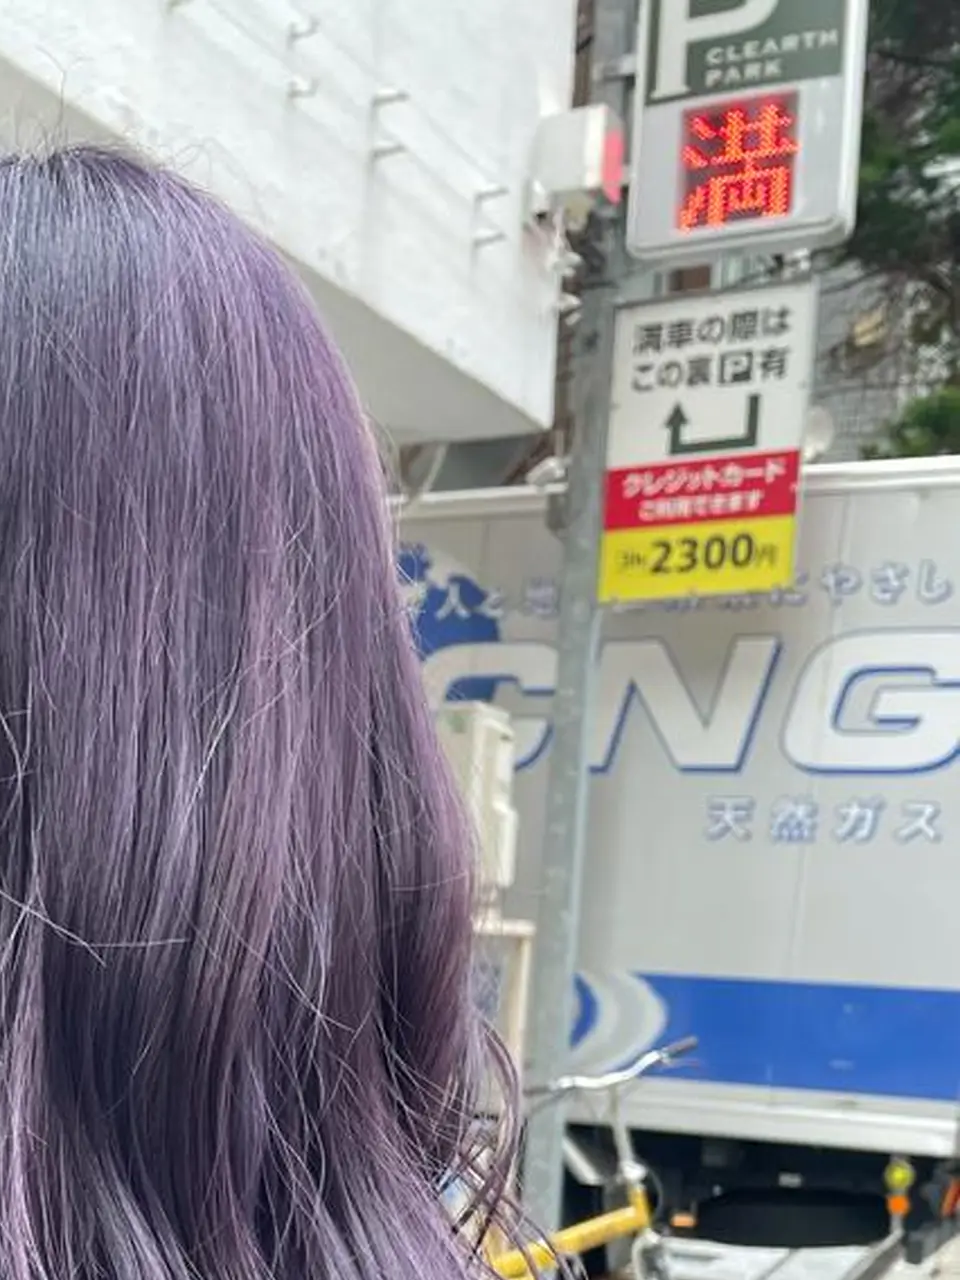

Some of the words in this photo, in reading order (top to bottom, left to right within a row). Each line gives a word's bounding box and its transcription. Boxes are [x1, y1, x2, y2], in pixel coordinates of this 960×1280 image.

[706, 29, 838, 64] CLEARTH
[704, 58, 782, 88] PARK
[678, 103, 799, 231] 満
[635, 307, 790, 353] 満車の際は
[623, 458, 786, 497] クレジットカード
[704, 796, 943, 845] 天然ガス
